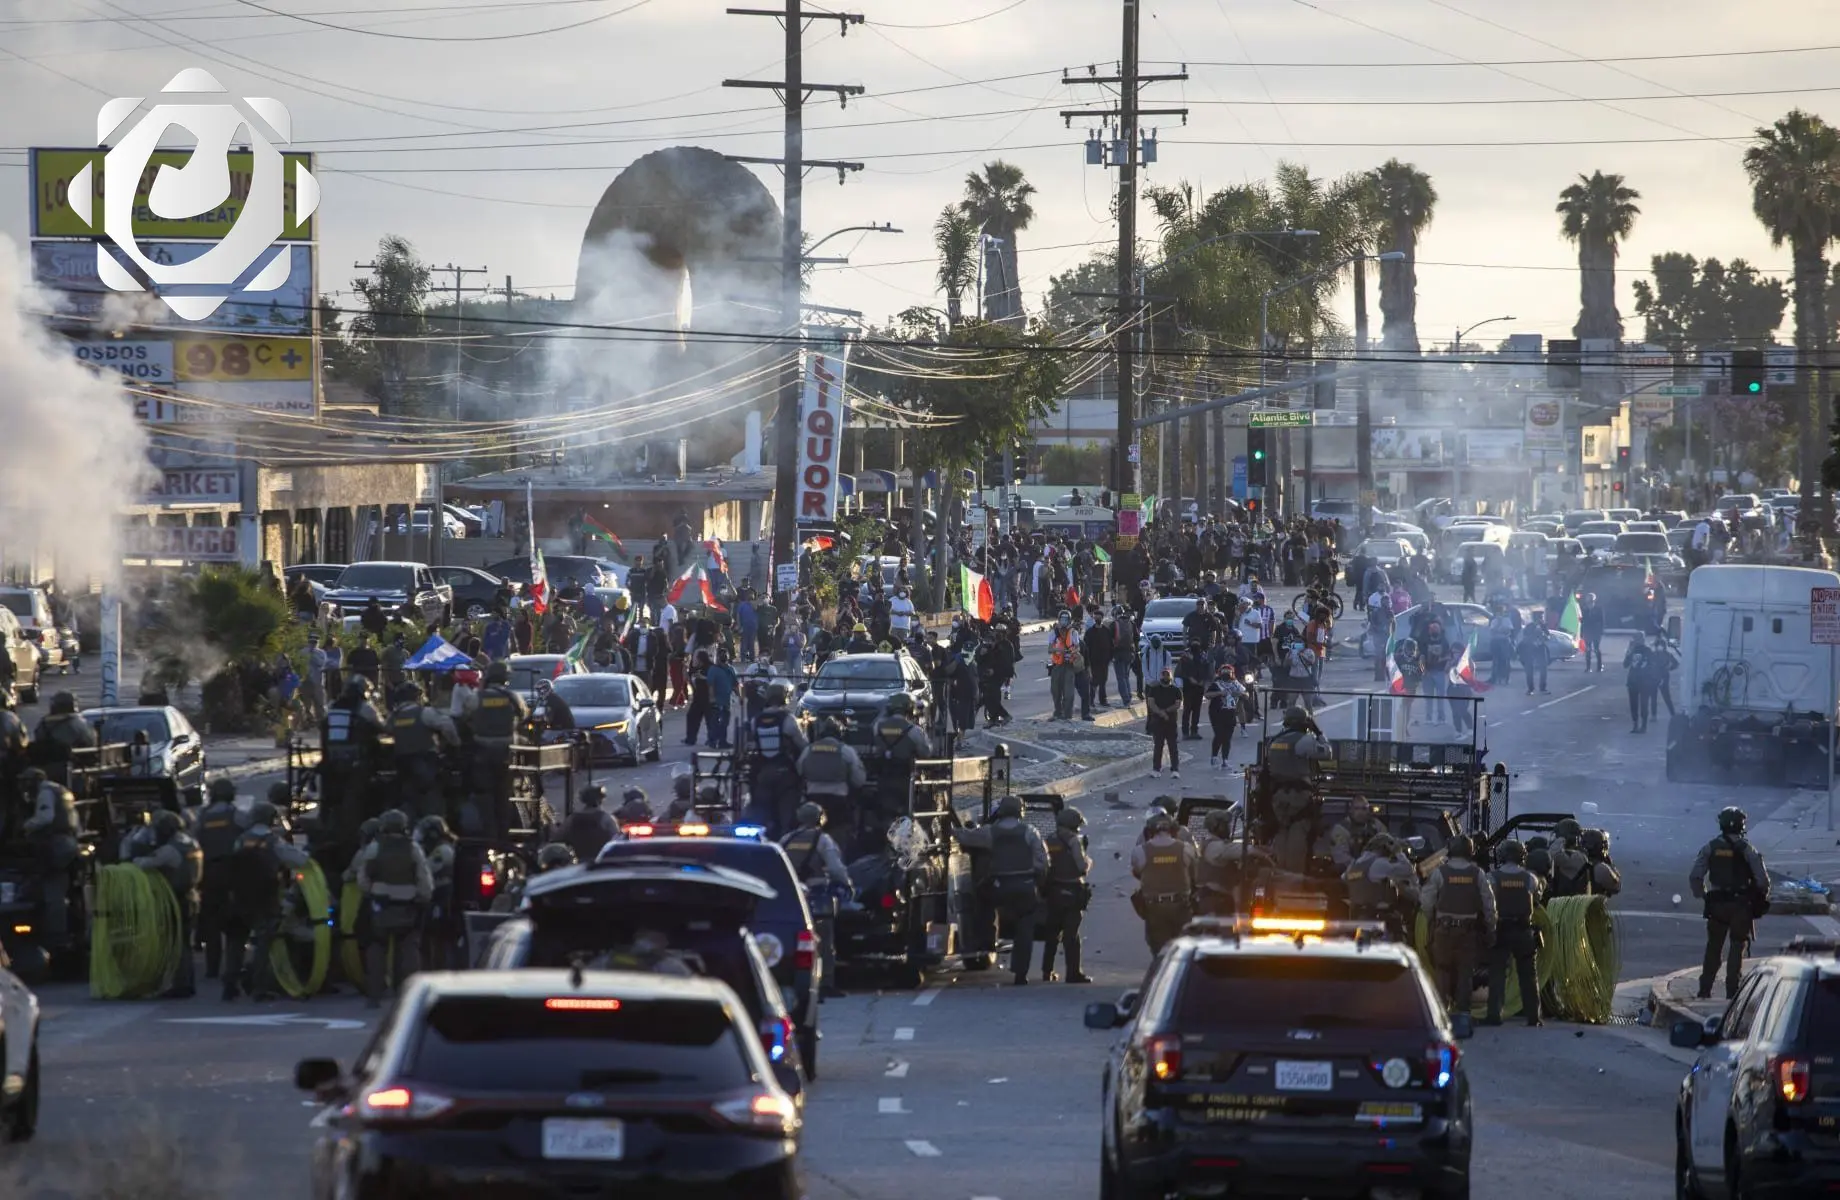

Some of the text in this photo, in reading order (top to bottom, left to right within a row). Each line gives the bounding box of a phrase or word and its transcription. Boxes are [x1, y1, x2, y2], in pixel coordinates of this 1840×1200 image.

[1251, 412, 1311, 422] Atlantic Blvd
[802, 356, 837, 518] LIQUOR
[147, 472, 236, 496] ARKET
[1205, 1107, 1268, 1121] SHERIFF
